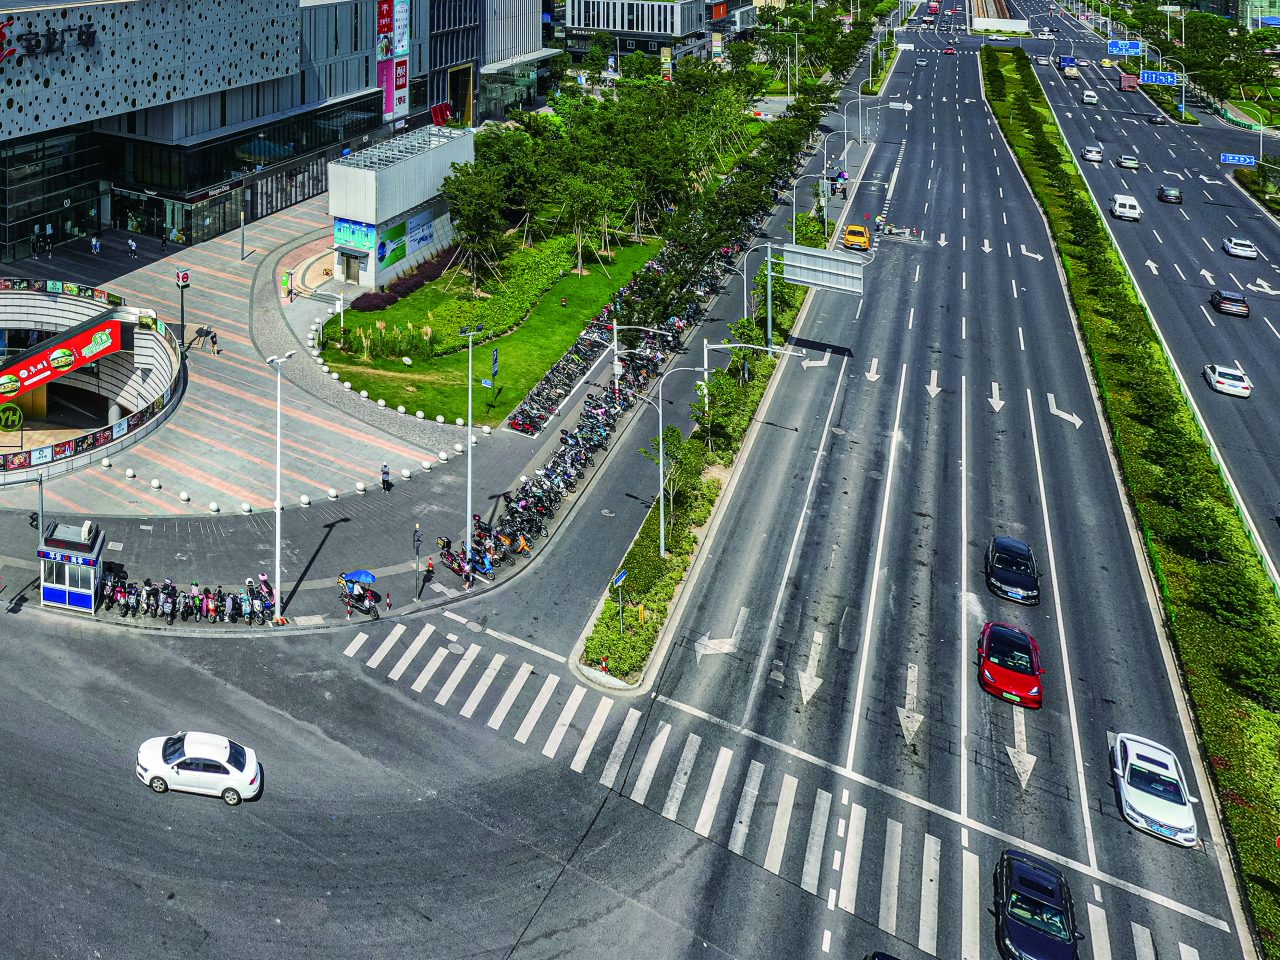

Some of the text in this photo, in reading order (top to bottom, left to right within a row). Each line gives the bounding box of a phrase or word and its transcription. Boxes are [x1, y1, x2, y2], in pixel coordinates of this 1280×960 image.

[16, 23, 97, 55] 宝龙广场
[0, 410, 20, 426] YH
